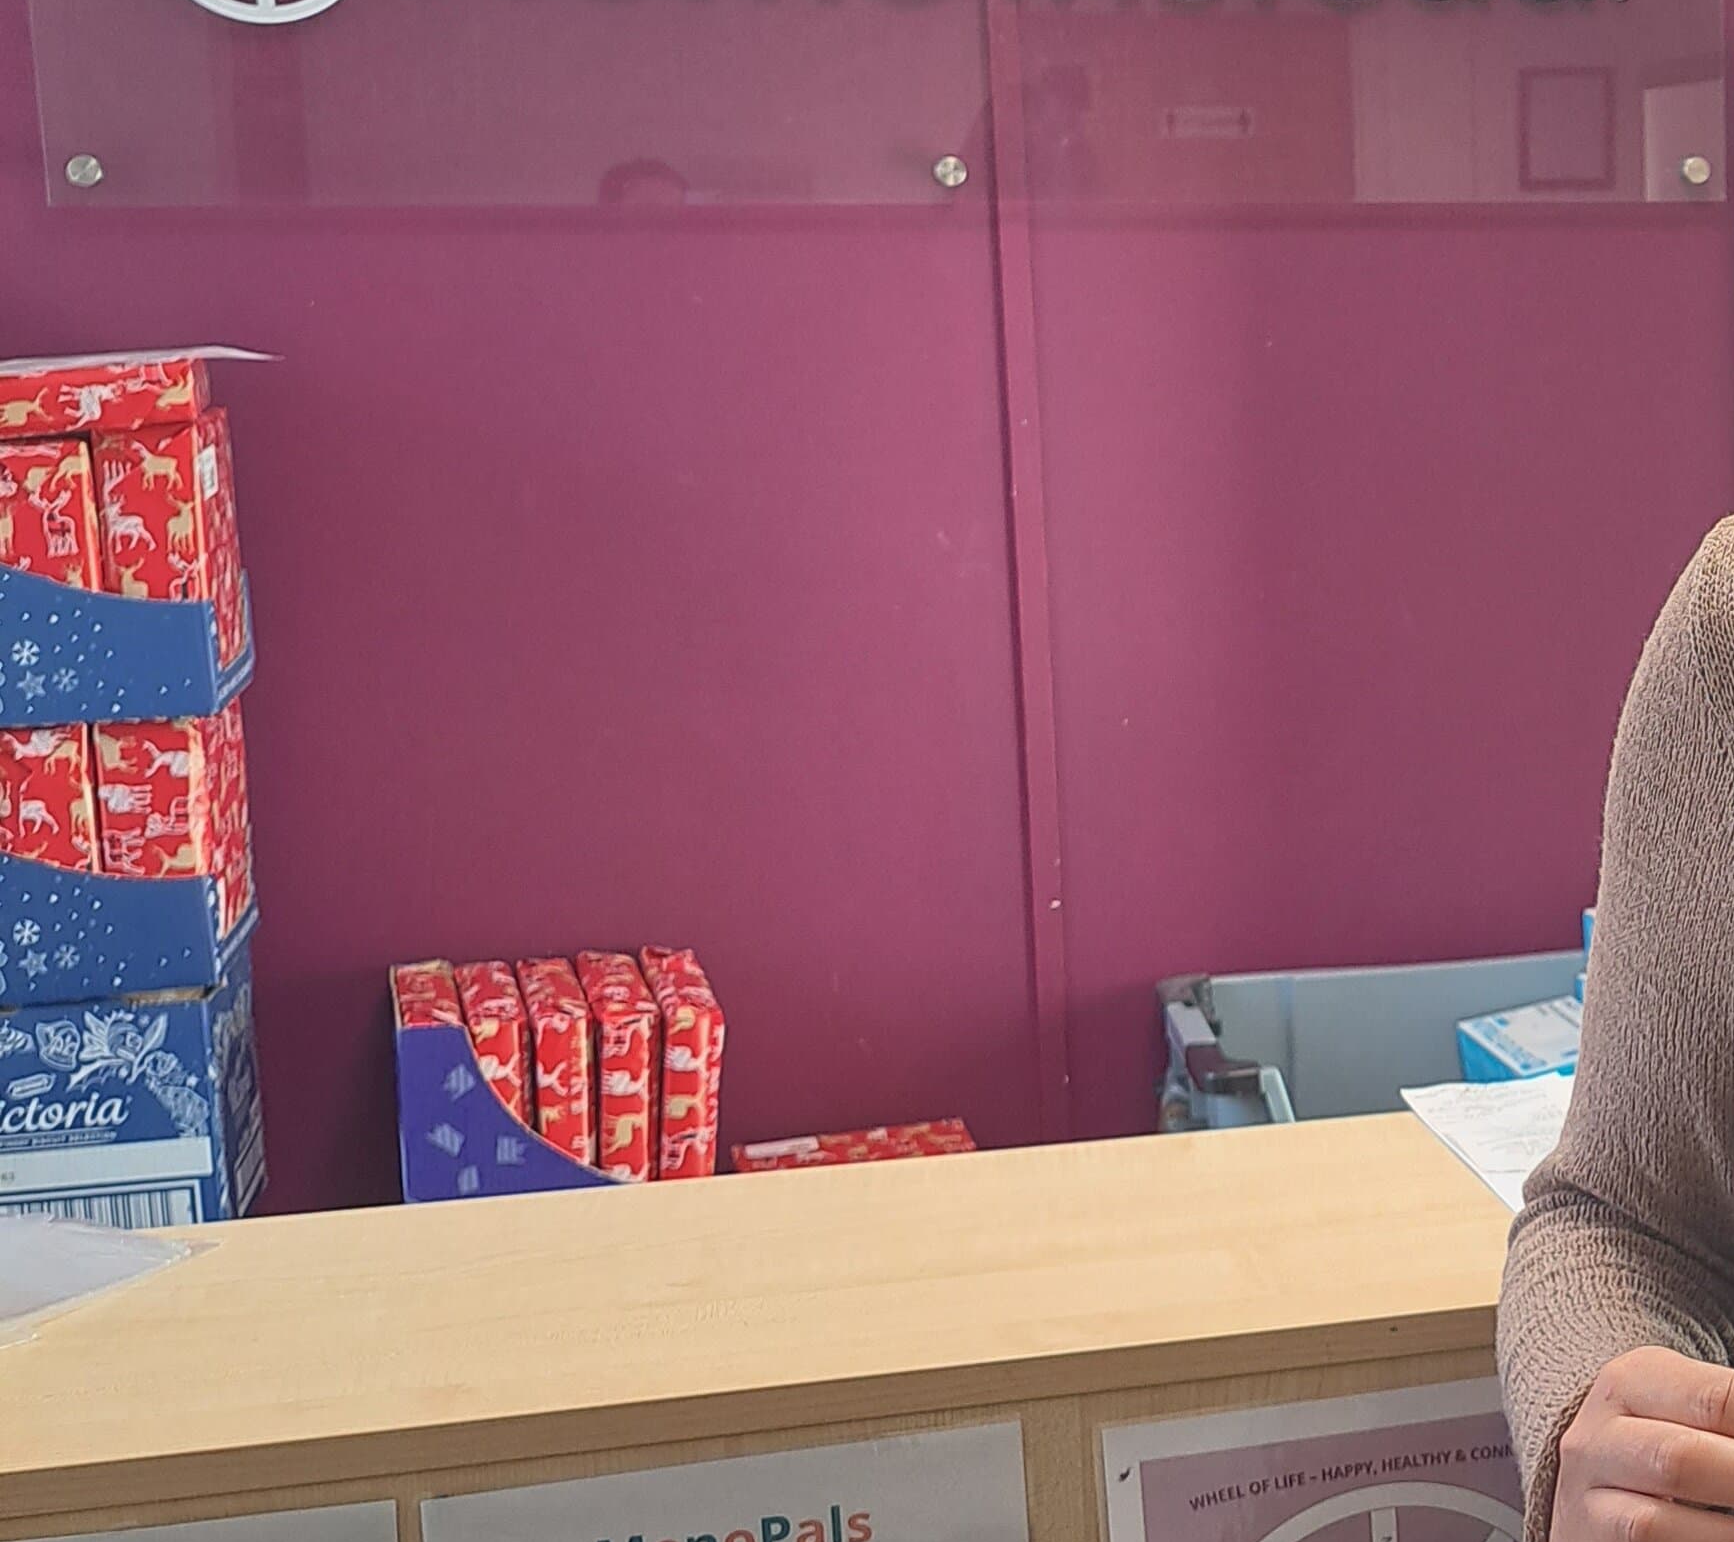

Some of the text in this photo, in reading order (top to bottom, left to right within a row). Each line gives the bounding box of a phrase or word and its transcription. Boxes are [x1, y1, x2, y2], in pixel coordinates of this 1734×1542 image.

[0, 1092, 129, 1133] ctoria
[1190, 1485, 1245, 1511] WHEEL
[1249, 1479, 1270, 1496] OF
[1274, 1472, 1305, 1490] LIFE
[1381, 1450, 1450, 1473] HEALTHY
